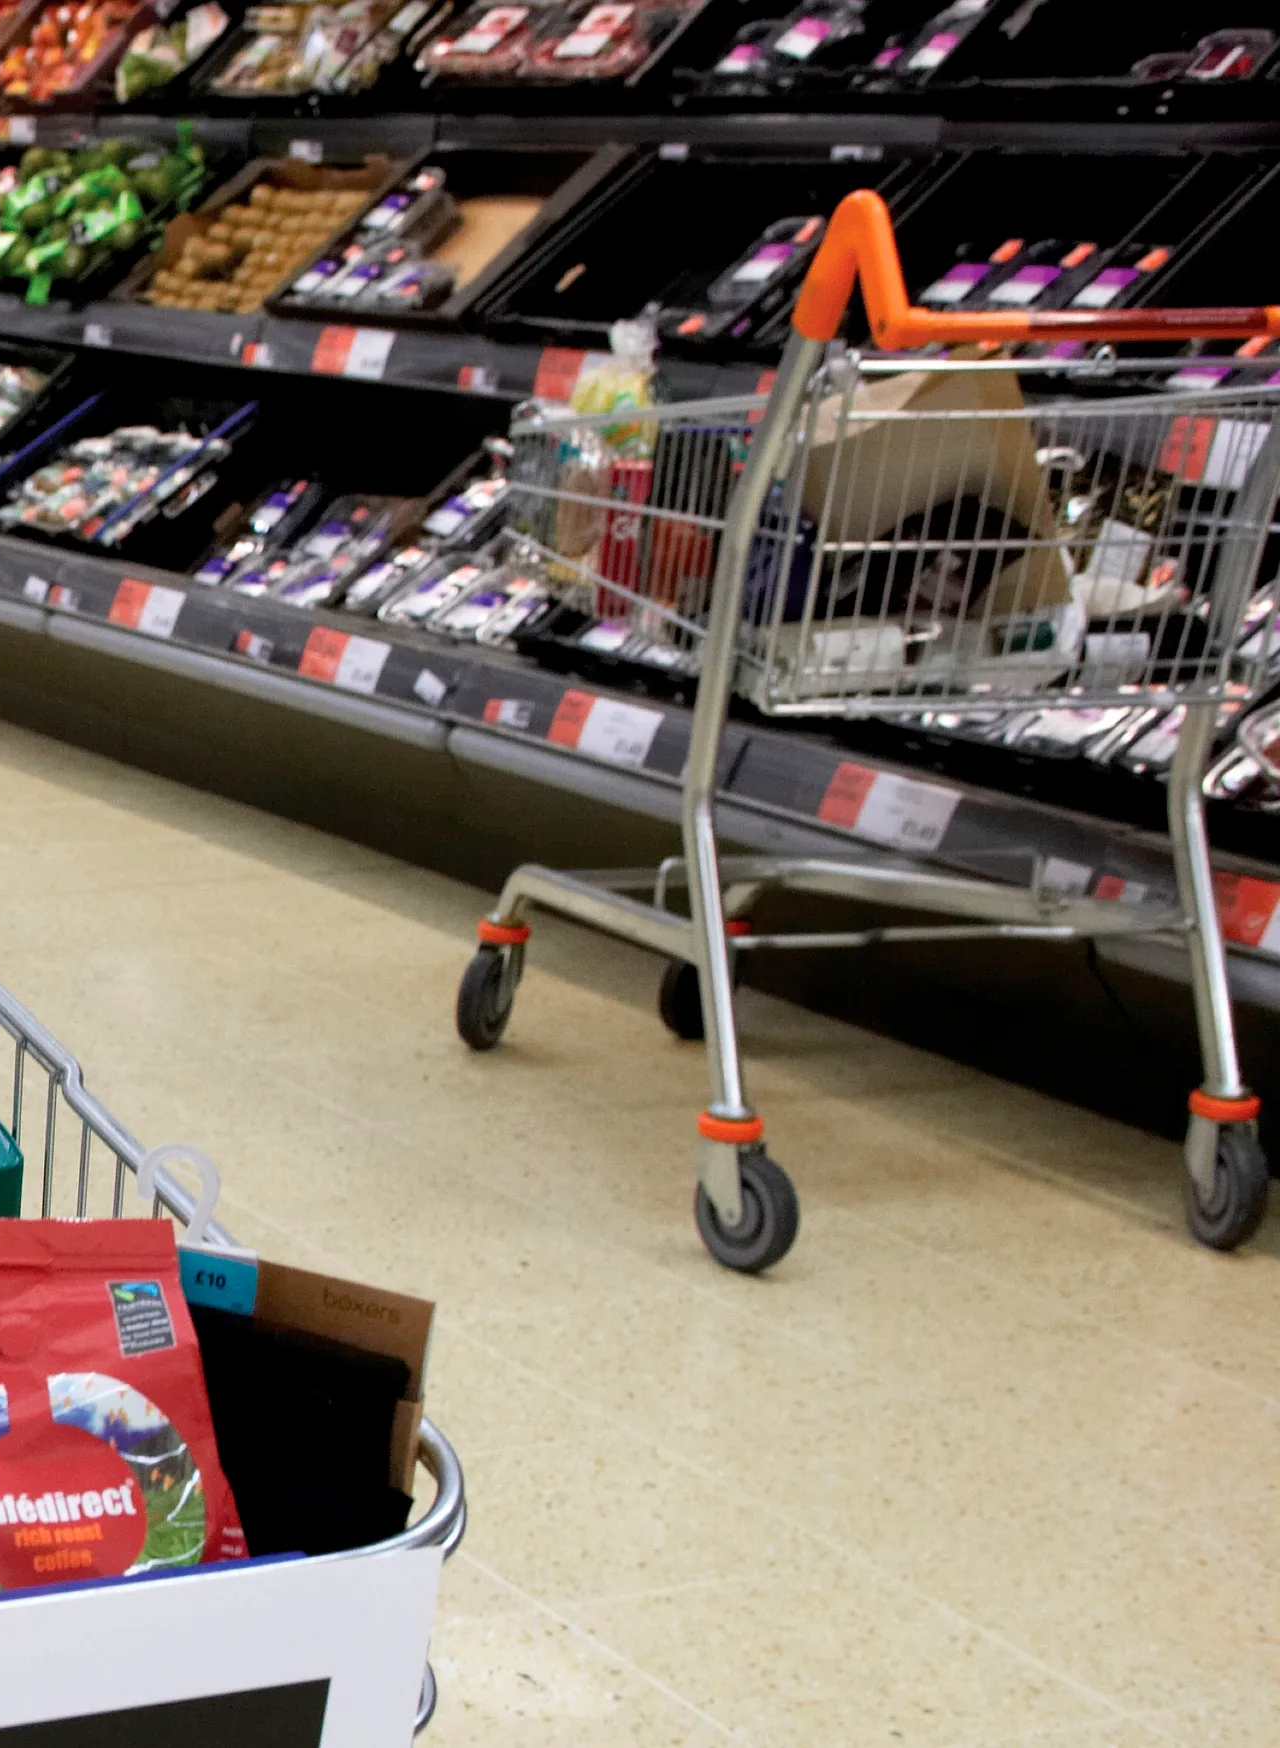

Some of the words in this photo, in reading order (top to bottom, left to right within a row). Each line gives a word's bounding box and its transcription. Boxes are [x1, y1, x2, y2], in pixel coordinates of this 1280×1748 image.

[195, 1269, 227, 1290] £10
[323, 1285, 402, 1325] boxers
[14, 1525, 51, 1549] rich
[54, 1522, 105, 1545] roast
[32, 1548, 93, 1573] coffee
